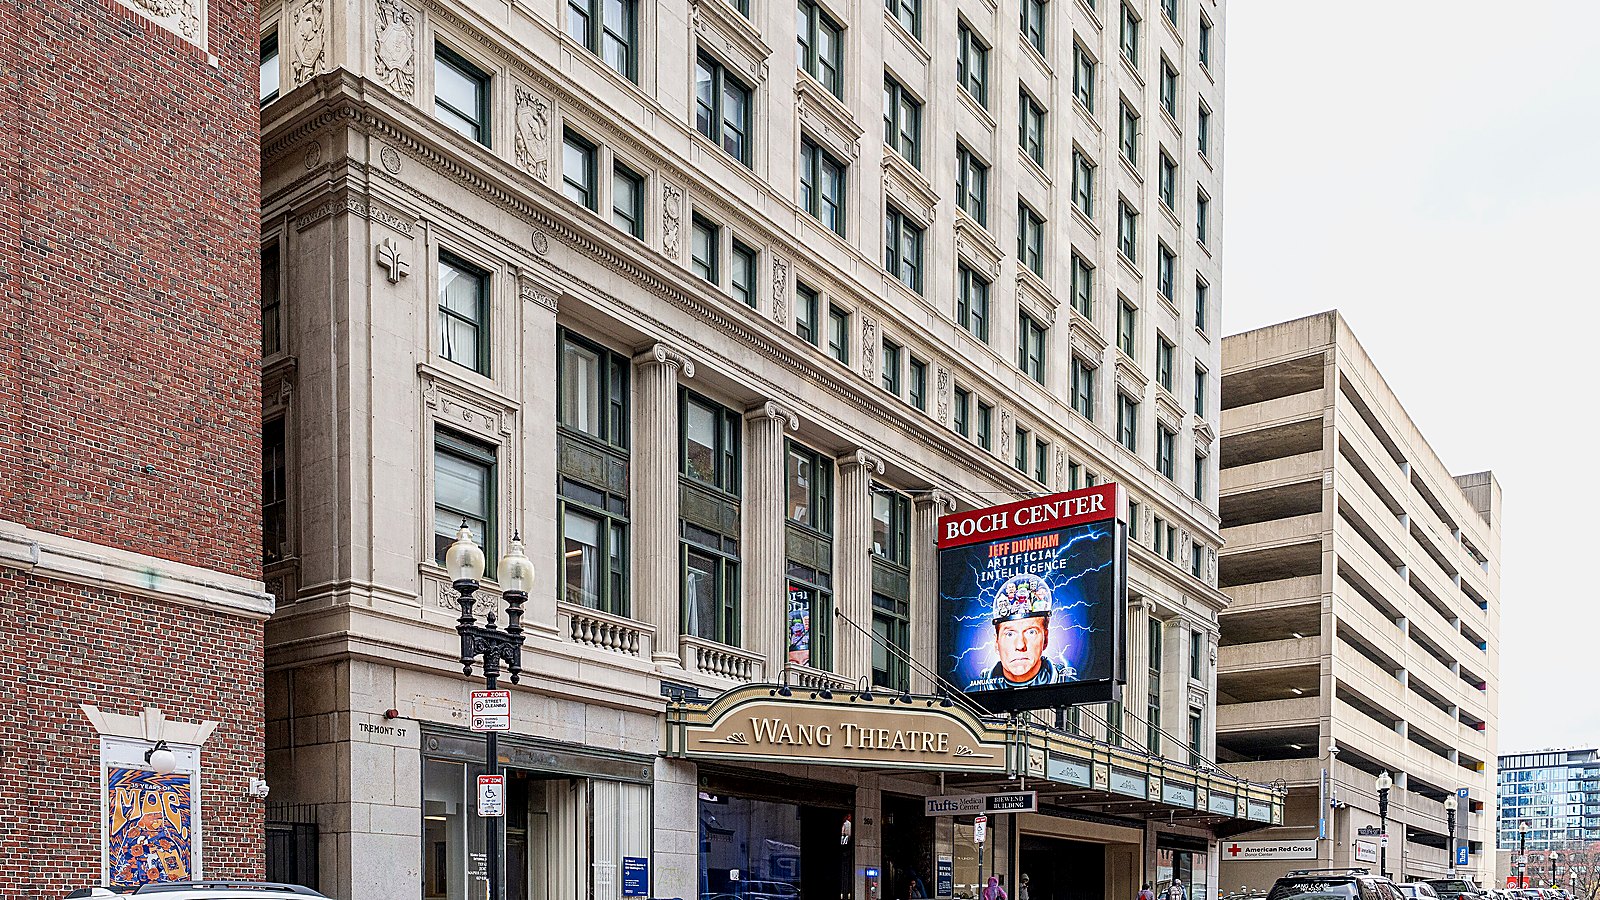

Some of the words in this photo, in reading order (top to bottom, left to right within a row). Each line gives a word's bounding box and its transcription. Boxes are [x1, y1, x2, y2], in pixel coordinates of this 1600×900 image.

[946, 512, 1008, 539] BOCH
[1014, 493, 1106, 526] CENTER
[988, 542, 1010, 558] JEFF
[1011, 534, 1059, 554] DUNHAM
[981, 558, 1067, 582] INTELLIGENCE
[987, 549, 1059, 569] ARTIFICIAL
[970, 679, 997, 687] JANUARY
[359, 723, 394, 735] TREMONT
[397, 728, 407, 737] ST
[750, 717, 833, 747] WANG
[840, 723, 950, 754] THEATRE
[928, 799, 958, 812] Tufts
[960, 797, 983, 805] Medical
